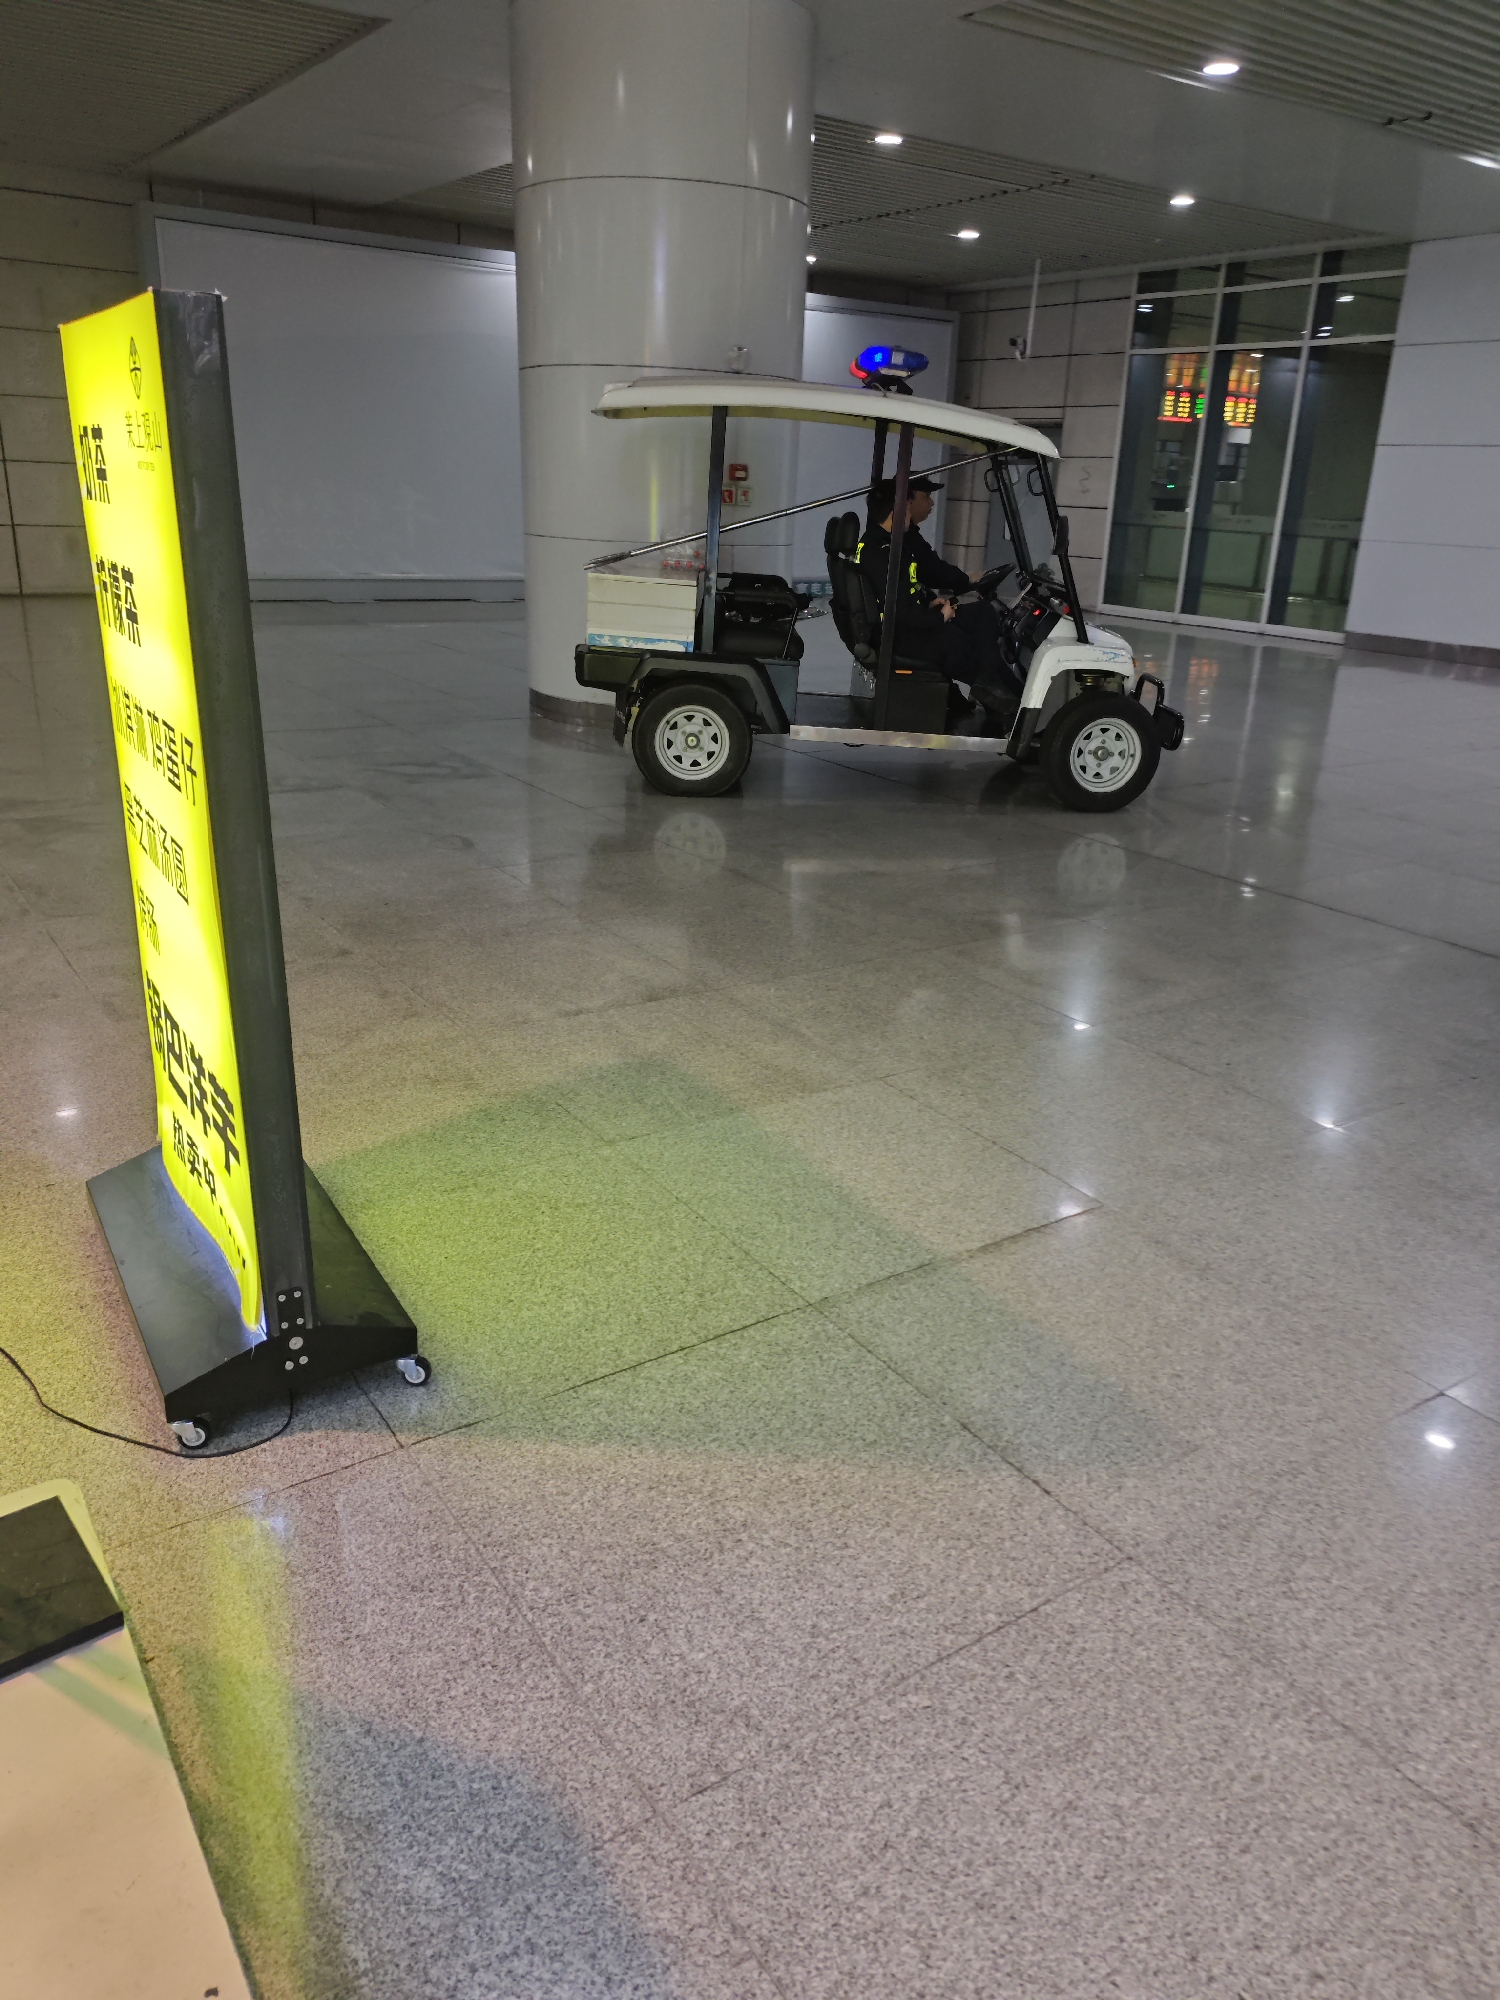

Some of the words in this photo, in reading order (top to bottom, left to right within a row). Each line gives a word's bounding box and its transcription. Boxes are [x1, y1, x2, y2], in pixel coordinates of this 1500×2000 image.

[79, 424, 110, 503] 奶茶
[95, 554, 141, 647] 柠檬茶
[147, 709, 197, 806] 鸡蛋仔
[124, 781, 189, 905] 黑芝麻汤圆
[146, 970, 240, 1177] 锅巴洋芋
